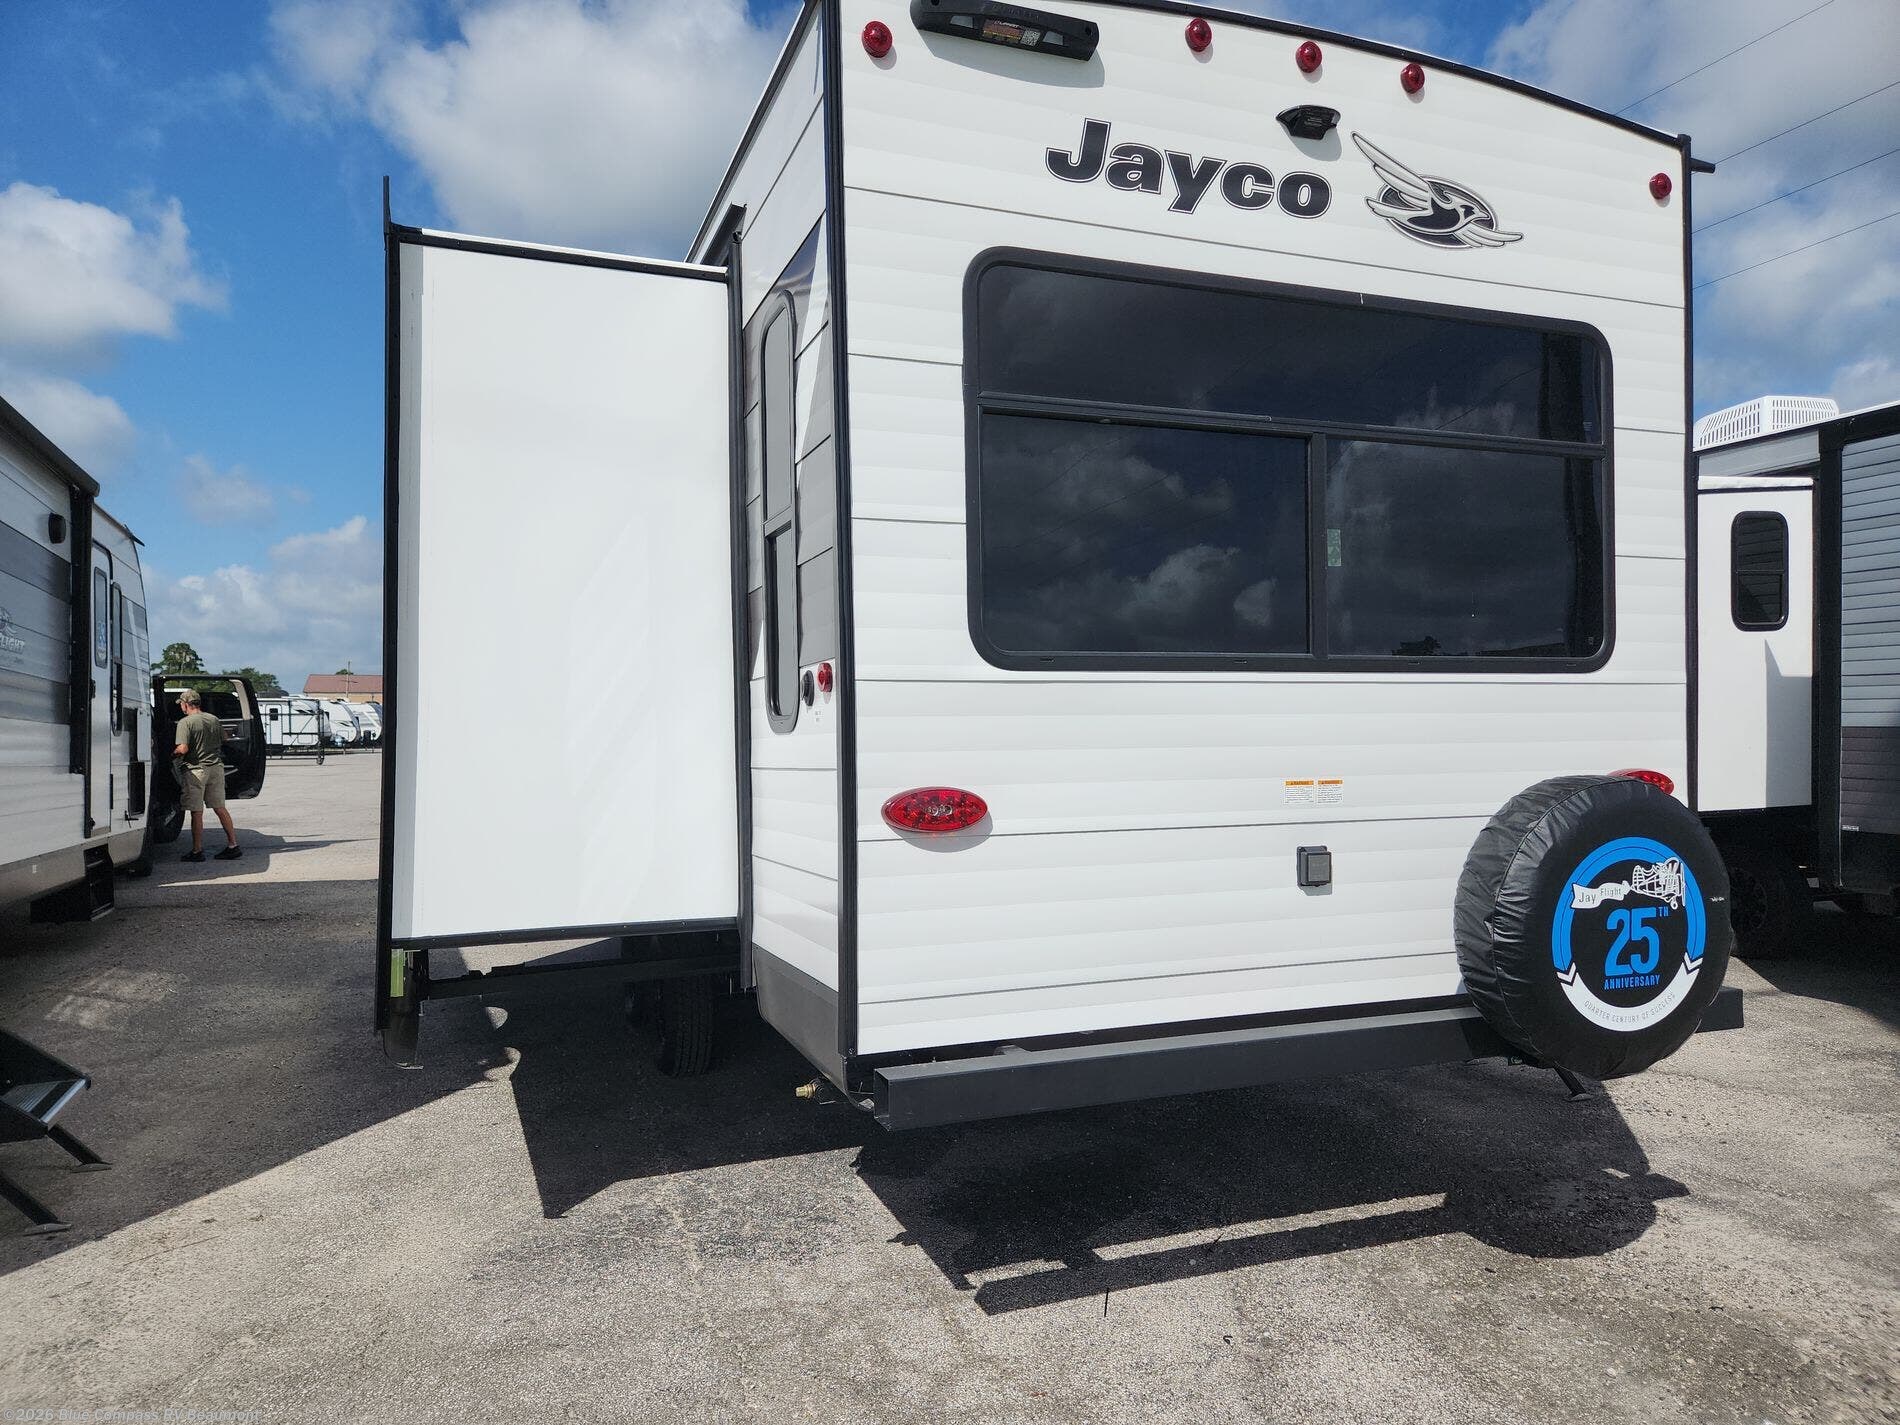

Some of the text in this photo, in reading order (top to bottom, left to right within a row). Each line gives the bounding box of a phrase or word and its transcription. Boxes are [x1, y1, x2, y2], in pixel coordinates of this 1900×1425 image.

[1045, 117, 1332, 219] Jayco
[1578, 887, 1622, 904] Jay Flight
[1603, 974, 1661, 990] ANNIVERSARY
[1584, 1000, 1611, 1022] QUARTER
[1611, 1012, 1640, 1023] CENTURY
[1641, 1010, 1650, 1020] OF
